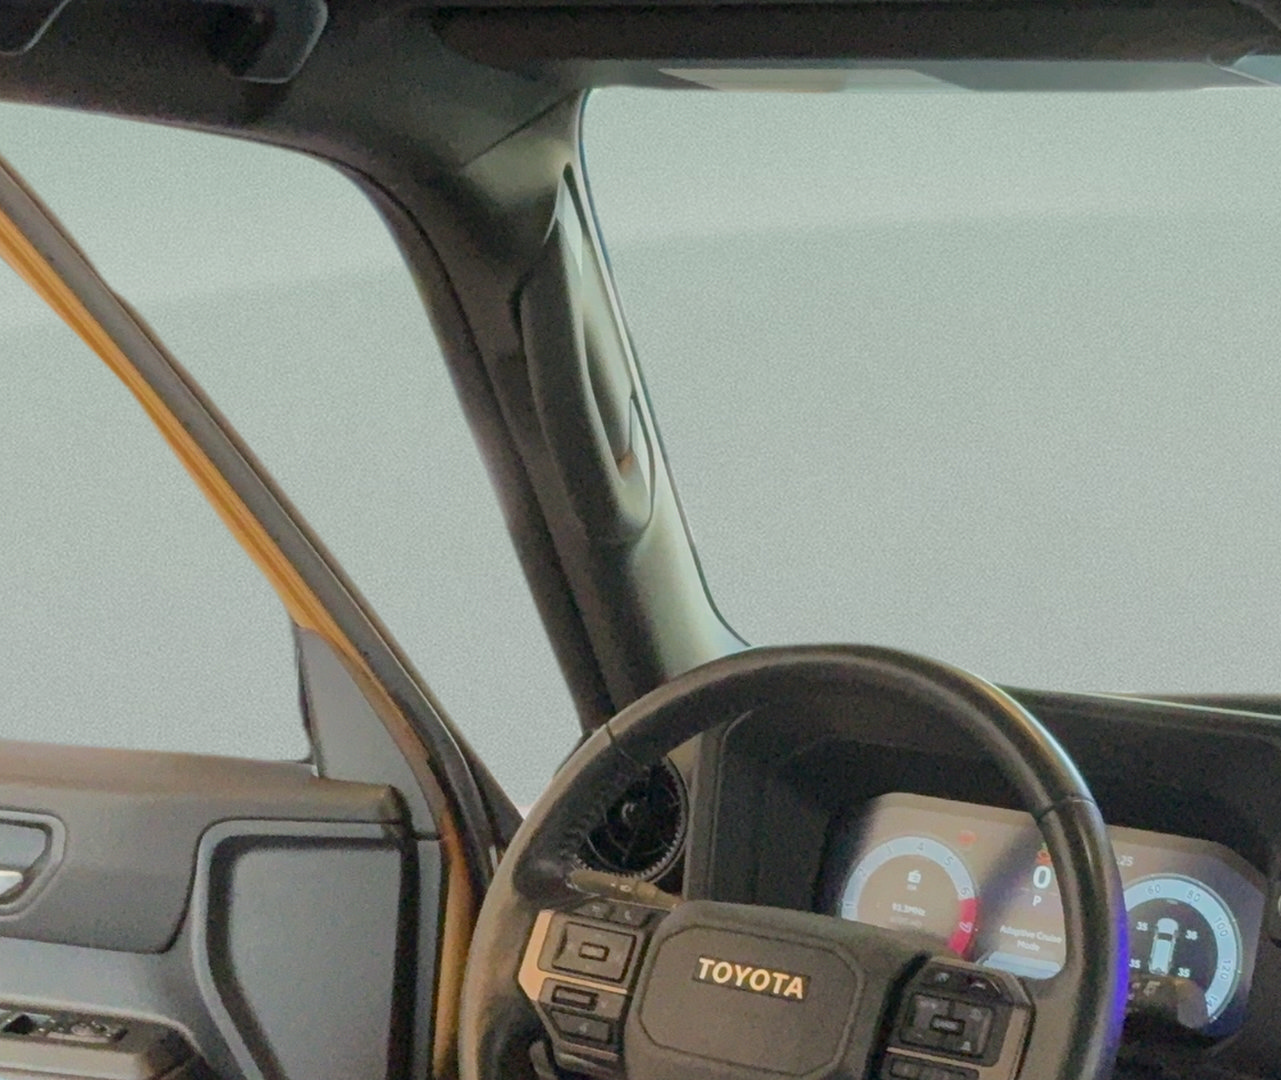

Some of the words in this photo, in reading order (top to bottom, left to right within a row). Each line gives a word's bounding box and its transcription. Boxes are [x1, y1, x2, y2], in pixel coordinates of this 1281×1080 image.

[1033, 865, 1052, 889] 0
[1146, 884, 1161, 895] 60
[1032, 895, 1042, 907] P
[1017, 939, 1041, 952] Mode
[698, 956, 805, 1000] TOYOTA
